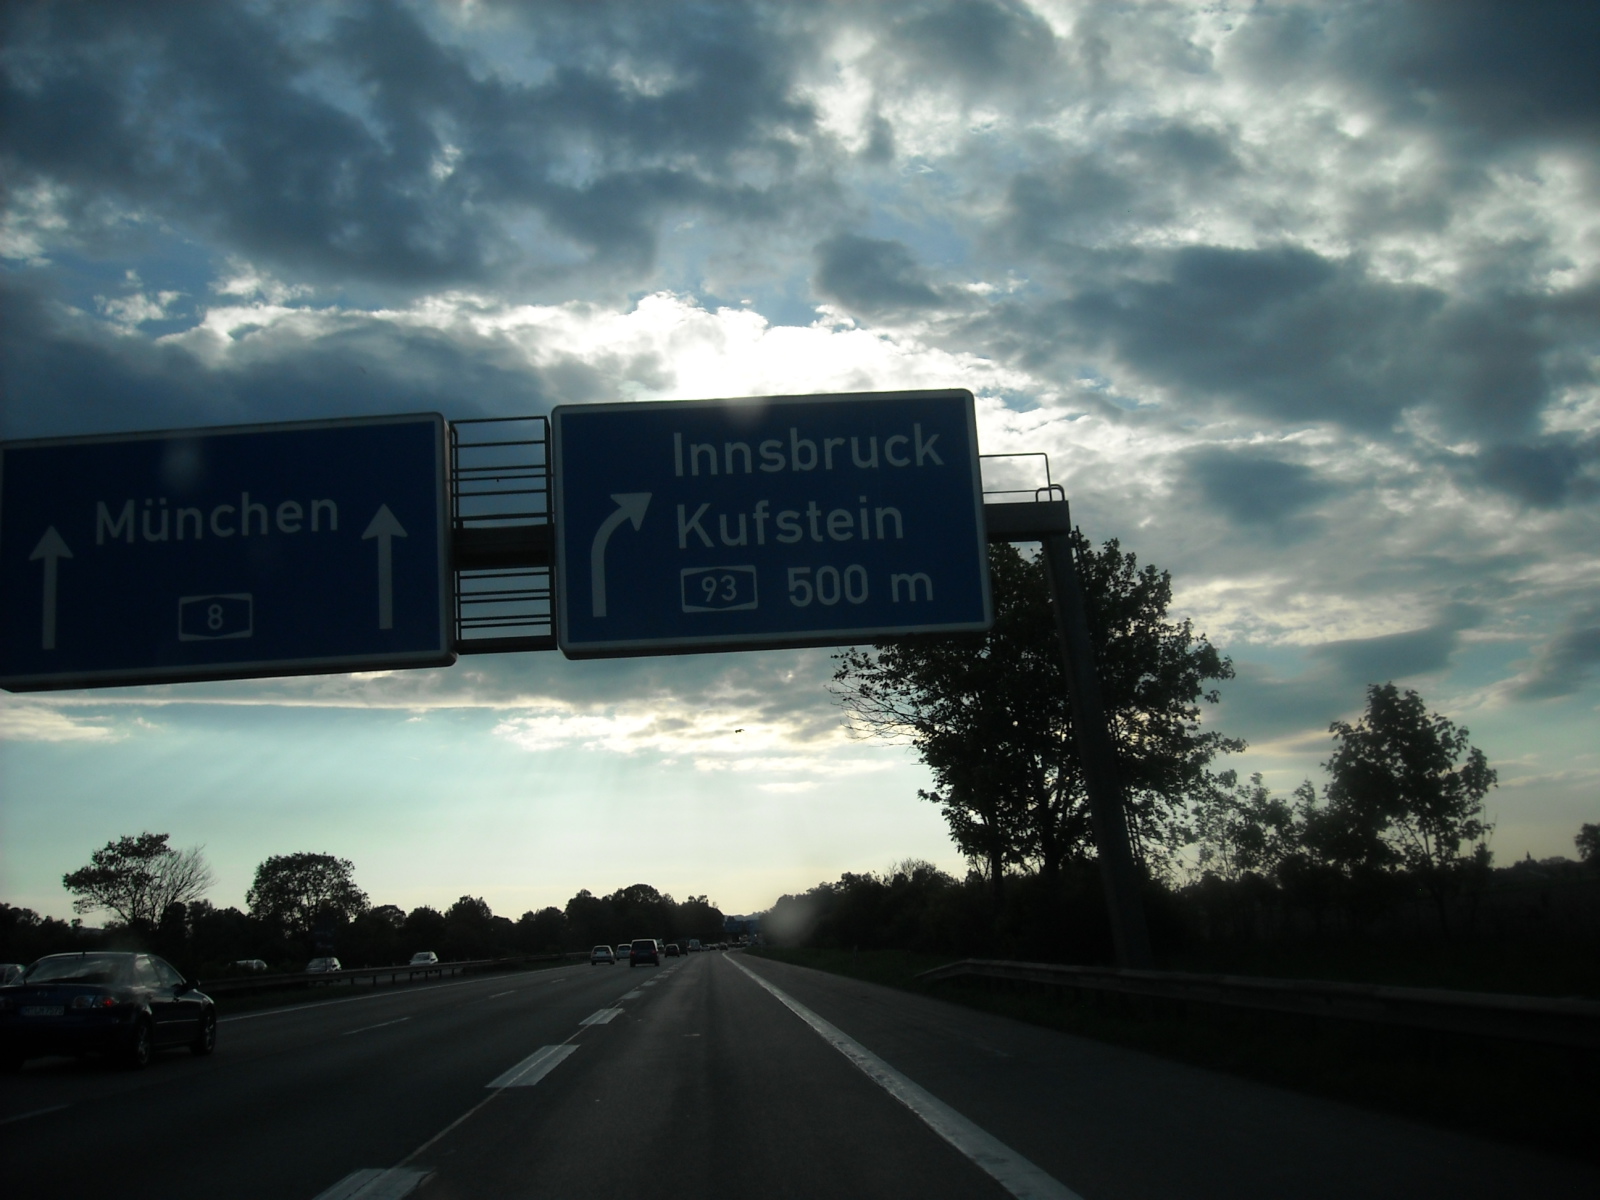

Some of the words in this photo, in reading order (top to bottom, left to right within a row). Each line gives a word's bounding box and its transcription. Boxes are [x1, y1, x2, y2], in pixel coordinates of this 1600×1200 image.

[673, 422, 944, 477] Innsbruck
[96, 491, 338, 545] München
[676, 495, 904, 550] Kufstein
[701, 574, 737, 603] 93
[787, 564, 869, 608] 500
[890, 572, 934, 603] m
[207, 603, 224, 630] 8
